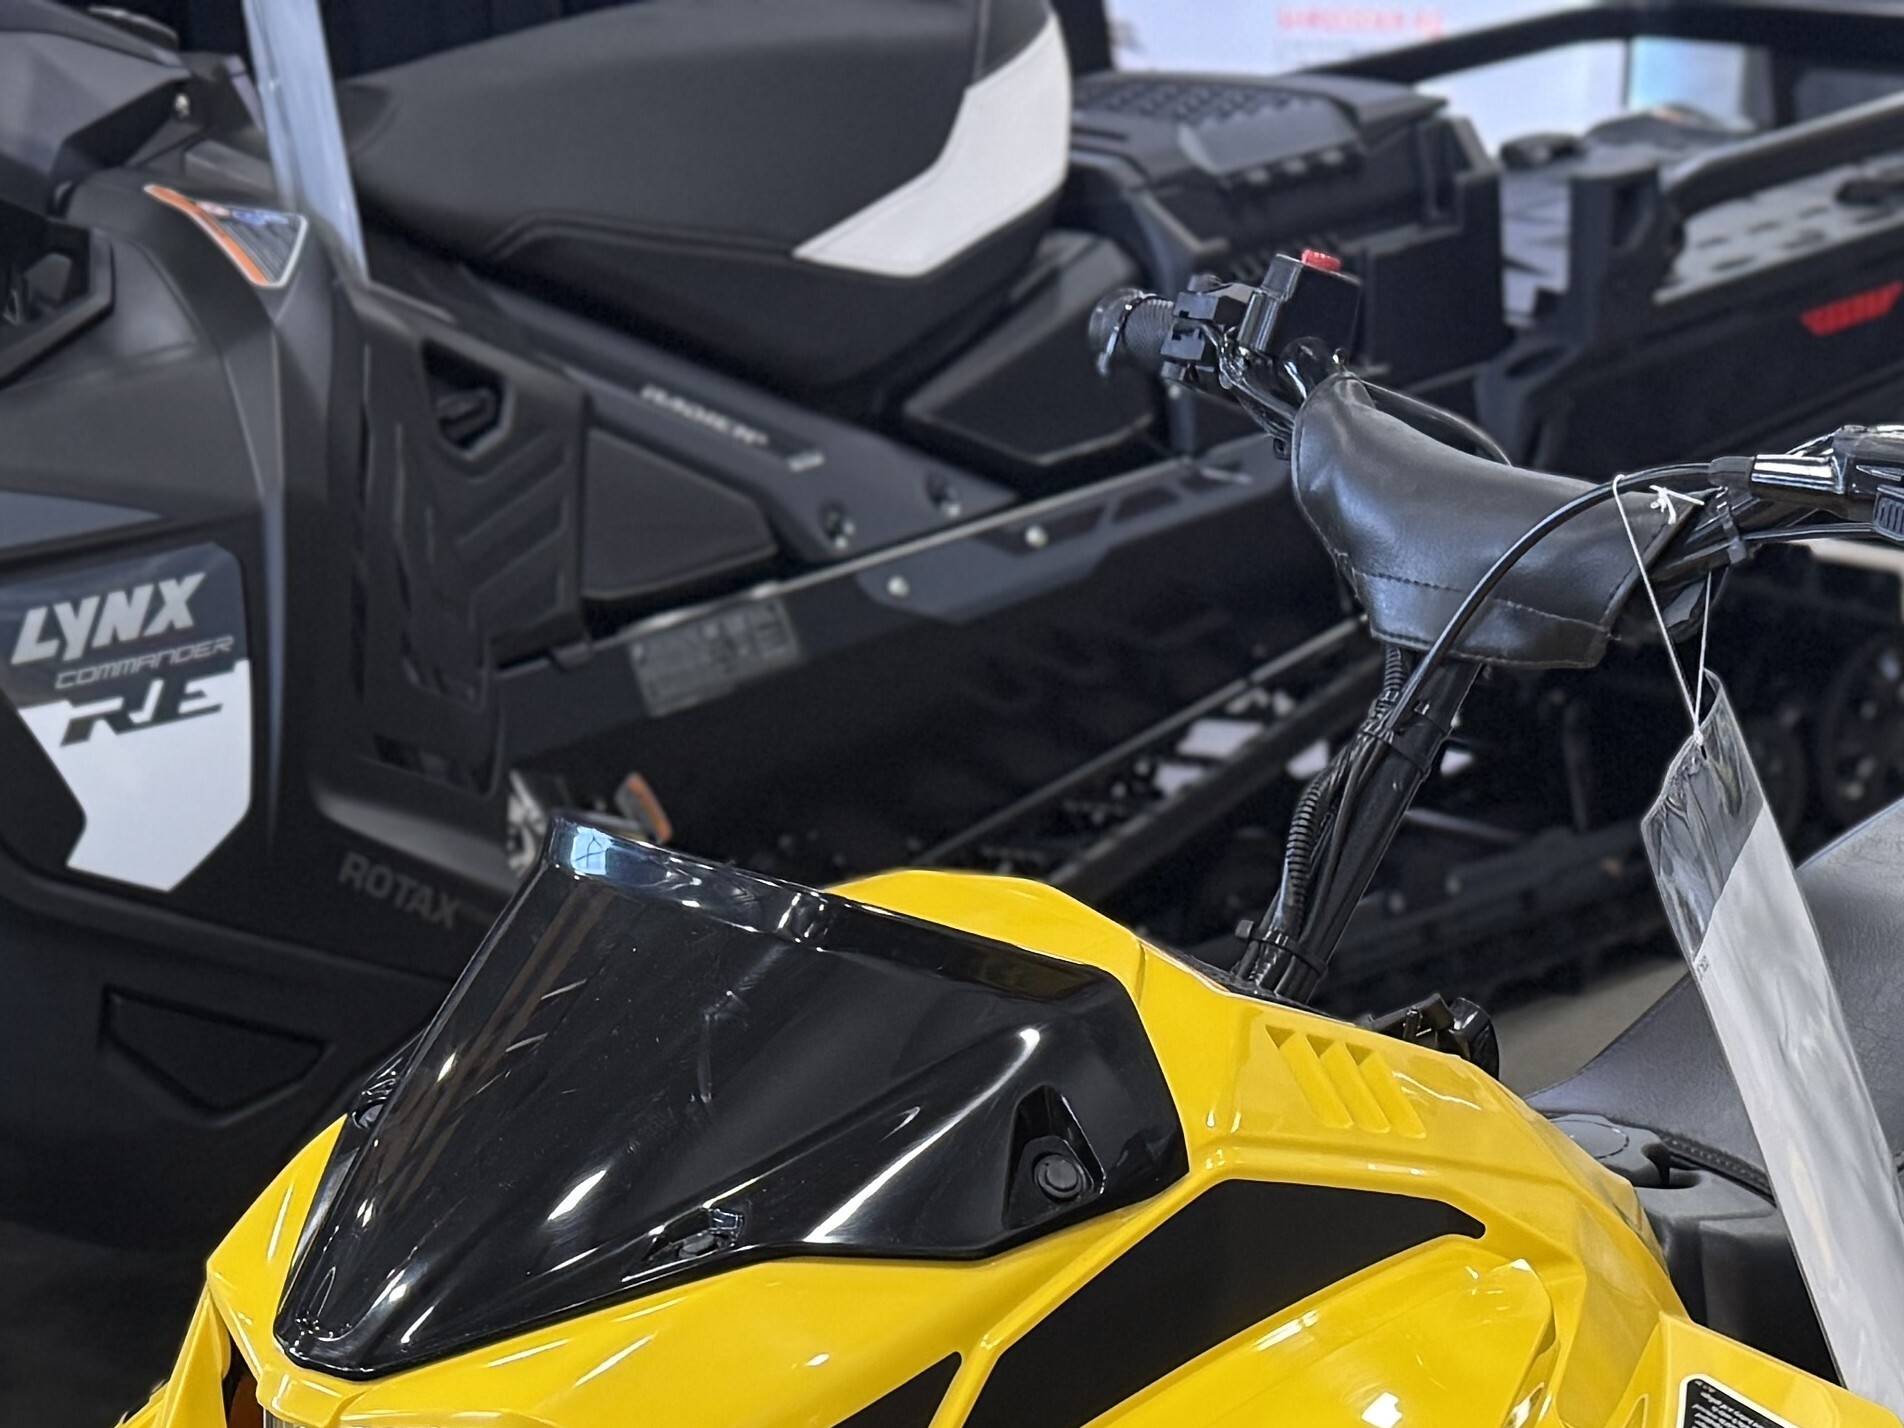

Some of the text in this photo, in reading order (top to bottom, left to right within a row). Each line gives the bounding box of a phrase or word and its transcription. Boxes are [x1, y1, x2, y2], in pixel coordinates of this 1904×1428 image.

[10, 572, 206, 665] LYNX
[54, 634, 235, 690] COMMANDER
[338, 852, 462, 930] ROTAX
